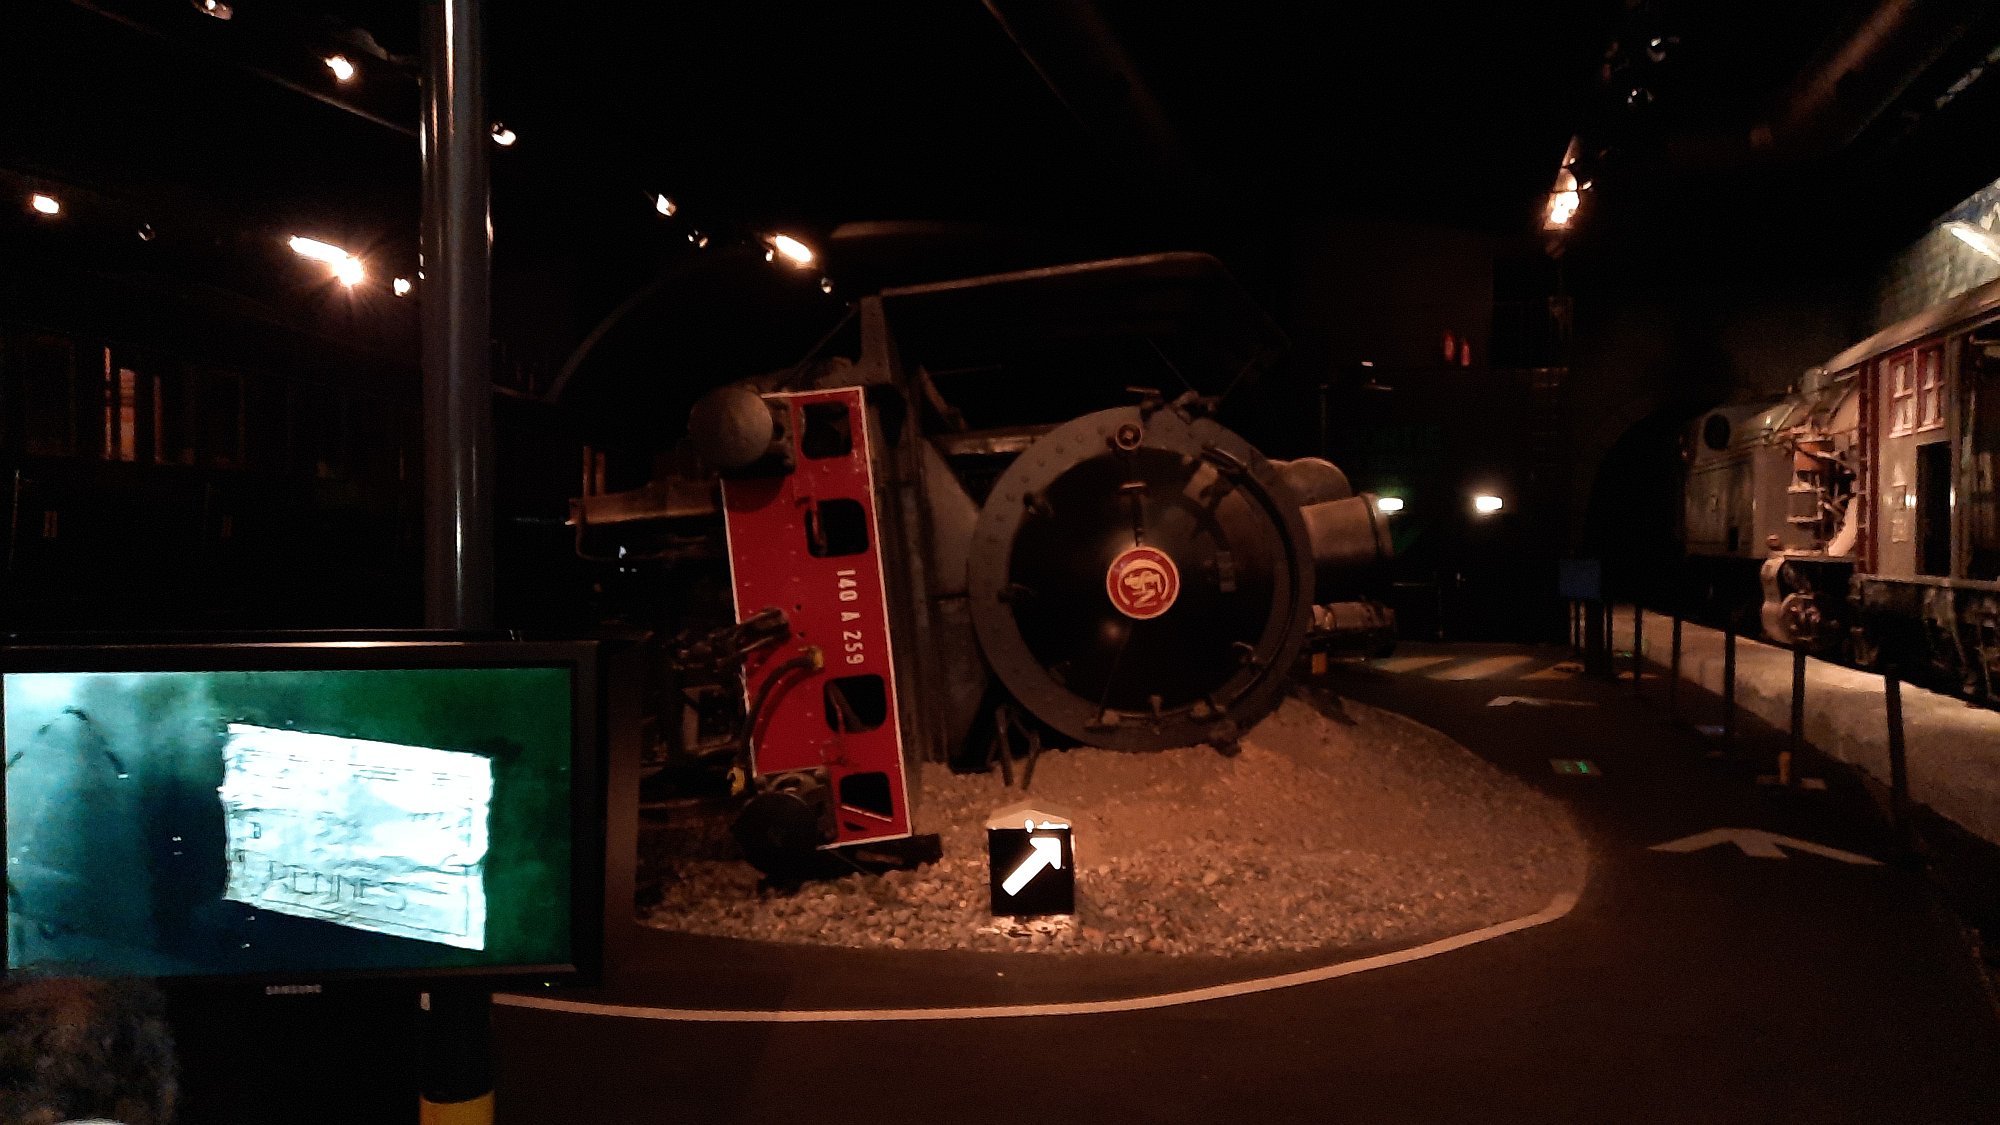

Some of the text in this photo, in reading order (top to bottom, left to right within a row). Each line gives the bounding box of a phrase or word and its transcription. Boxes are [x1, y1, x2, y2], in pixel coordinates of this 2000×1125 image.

[836, 569, 866, 665] 140 A 259
